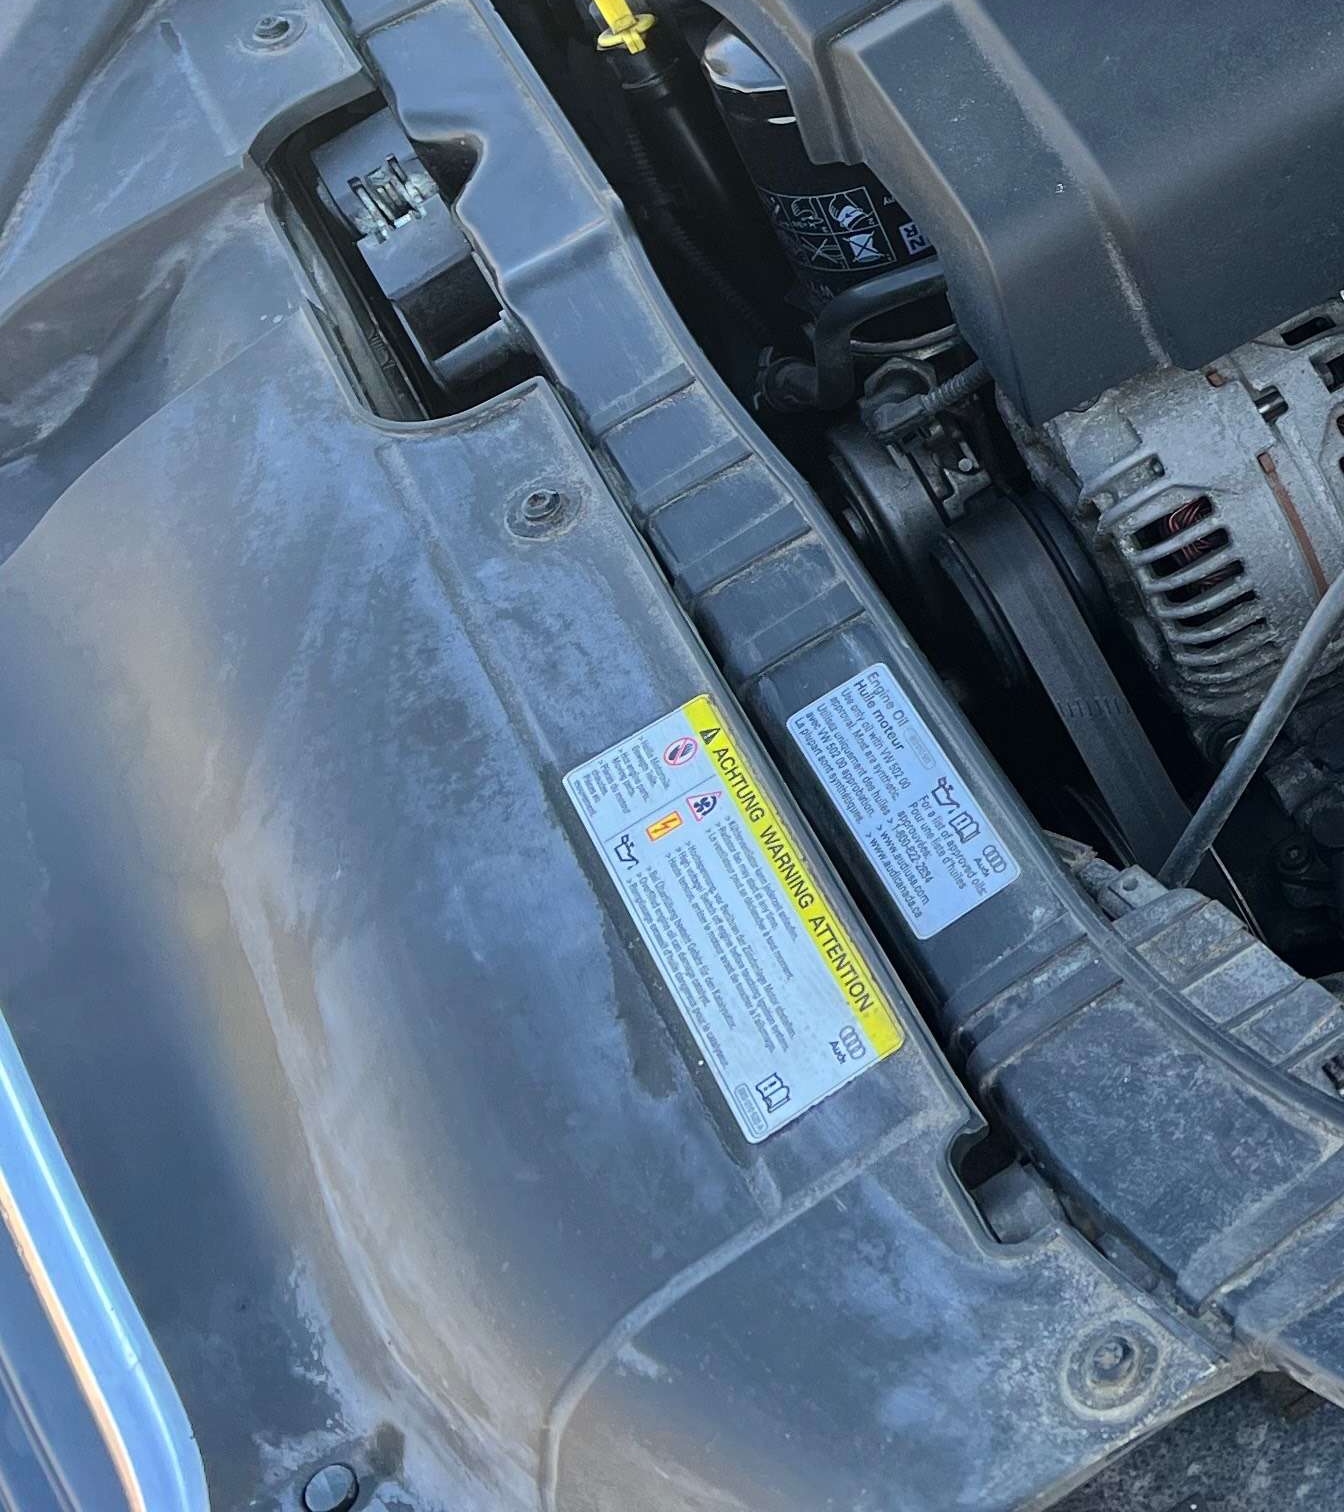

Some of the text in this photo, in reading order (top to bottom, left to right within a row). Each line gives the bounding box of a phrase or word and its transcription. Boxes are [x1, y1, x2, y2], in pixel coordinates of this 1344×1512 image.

[852, 678, 905, 753] Huile moteur
[863, 670, 909, 728] Engine Oil
[815, 727, 831, 744] VW
[867, 729, 885, 750] with
[878, 746, 895, 764] VW
[887, 760, 905, 780] 502
[907, 801, 926, 825] Pour
[918, 793, 934, 812] For
[940, 828, 953, 841] of
[711, 743, 875, 1013] ACHTUNG WARNING ATTENTION
